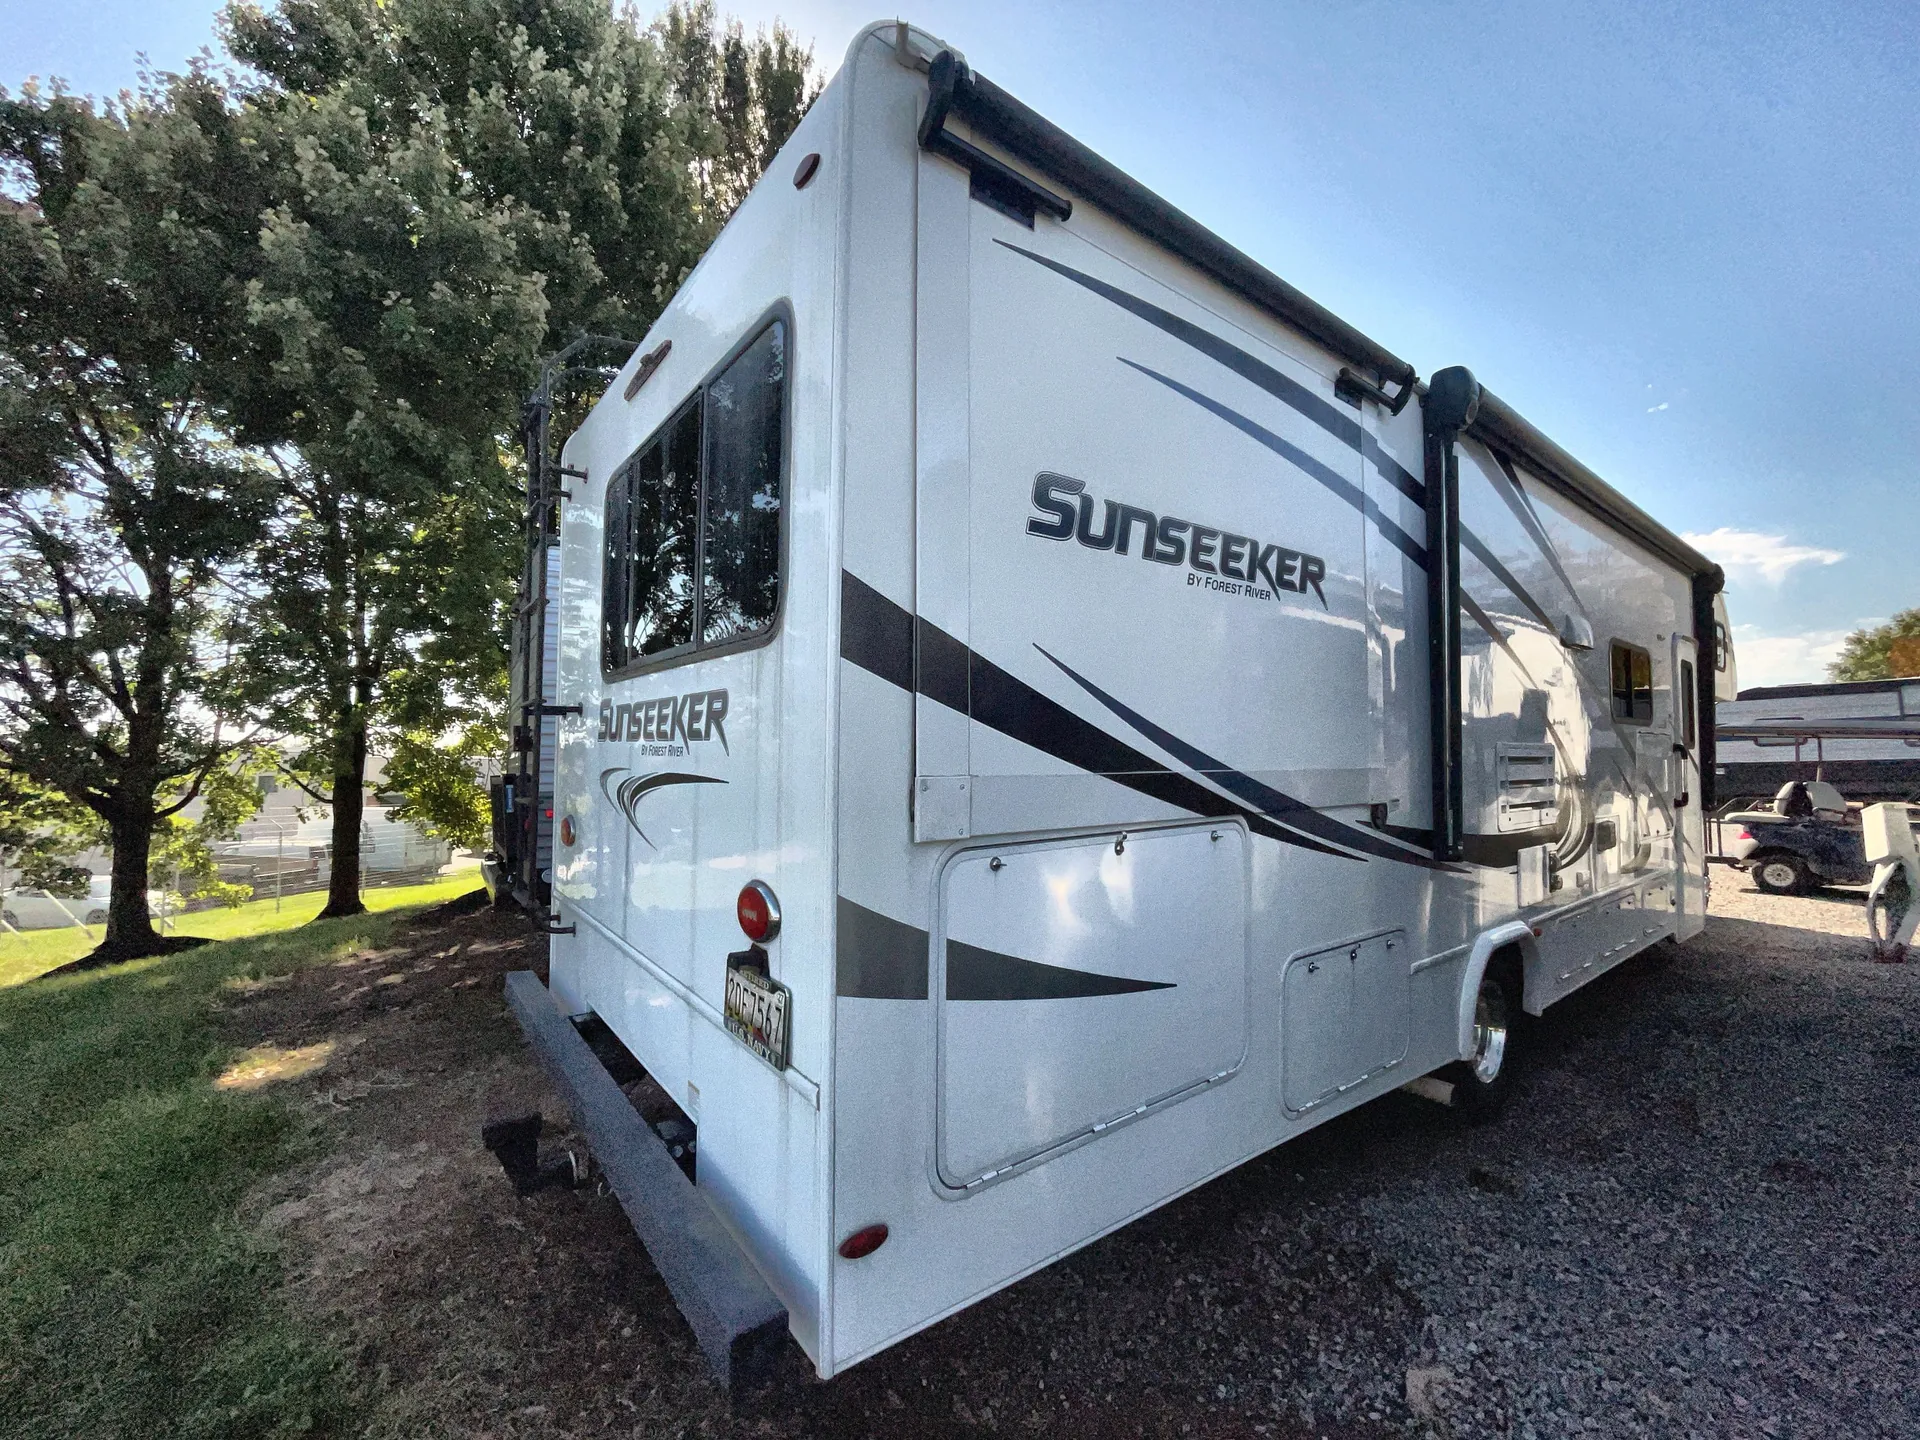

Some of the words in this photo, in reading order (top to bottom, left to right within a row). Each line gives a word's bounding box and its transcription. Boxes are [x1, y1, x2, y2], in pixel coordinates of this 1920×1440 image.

[1187, 572, 1202, 587] BY
[1204, 576, 1243, 596] FOREST
[1244, 584, 1271, 601] RIVER
[747, 1033, 771, 1060] NAVY
